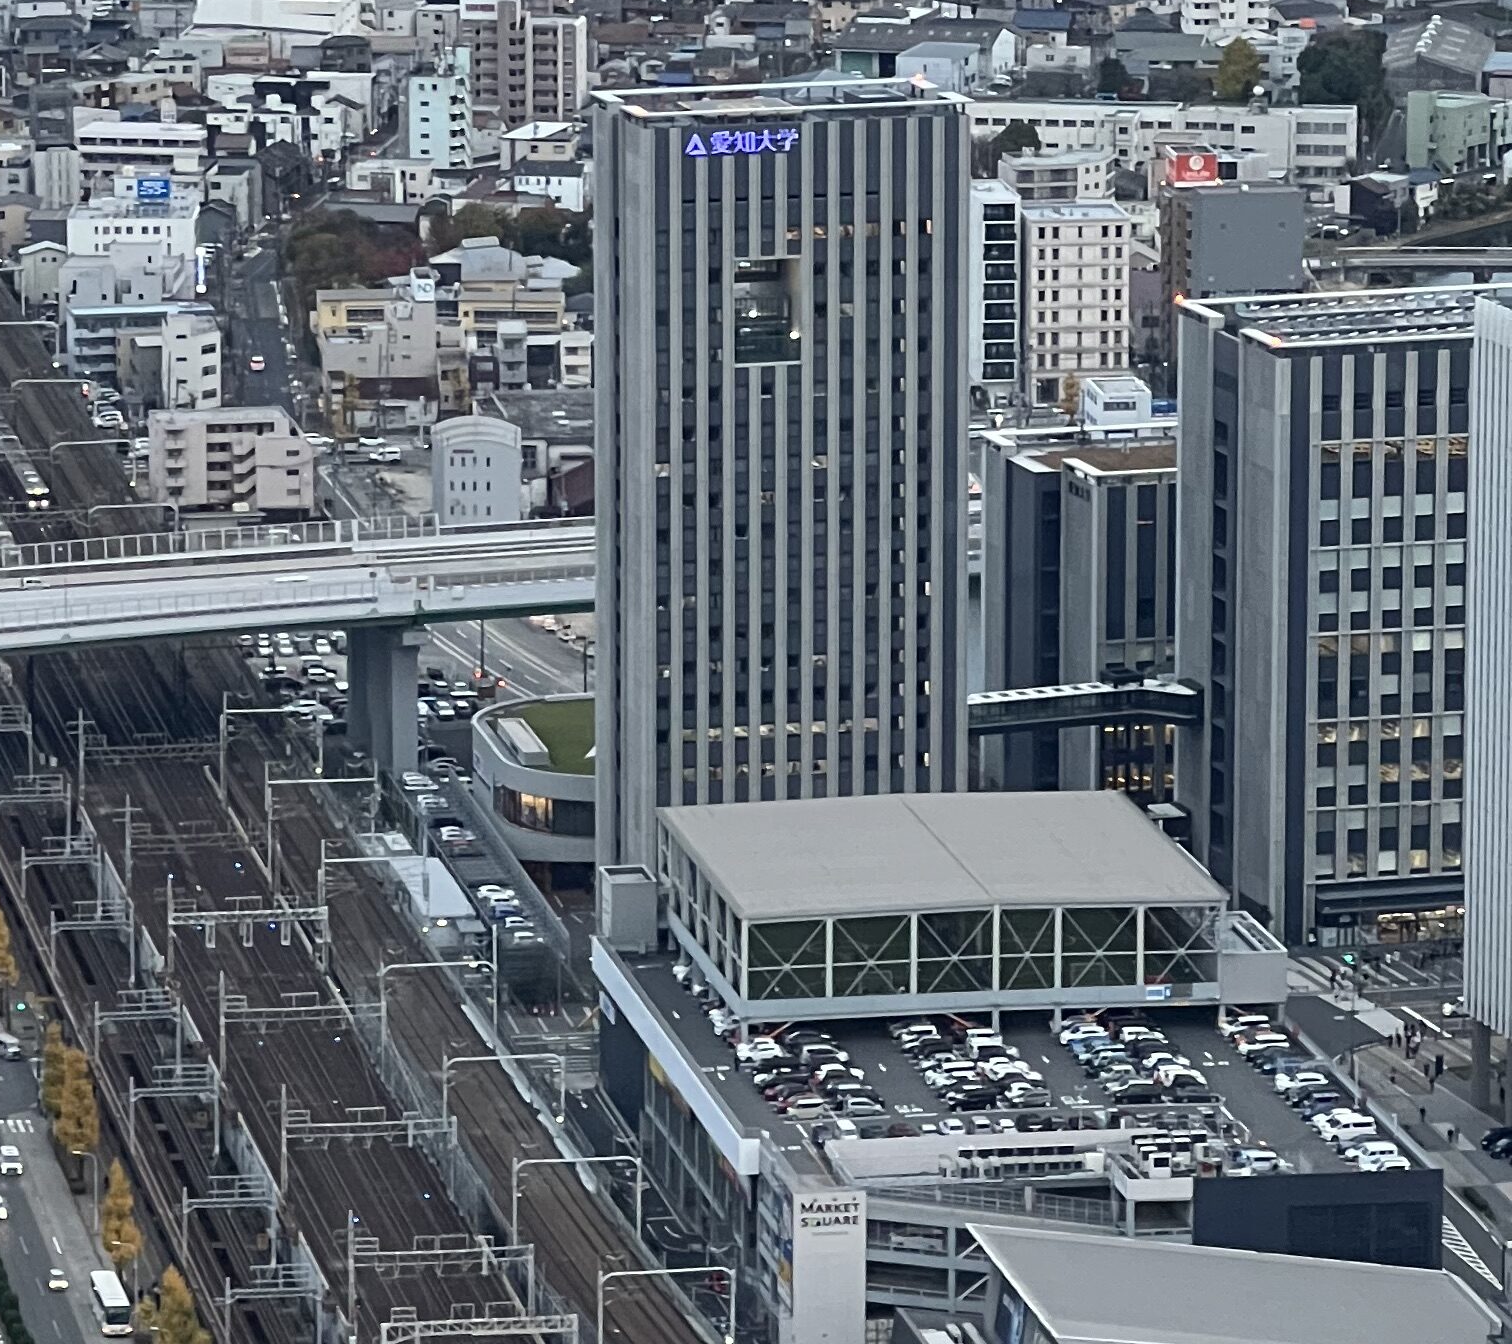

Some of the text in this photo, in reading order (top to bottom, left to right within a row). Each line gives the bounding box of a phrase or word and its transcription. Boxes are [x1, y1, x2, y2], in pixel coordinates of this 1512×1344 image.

[710, 128, 799, 155] 愛知大学
[800, 1201, 860, 1214] MARKET
[800, 1215, 859, 1228] SQUARE
